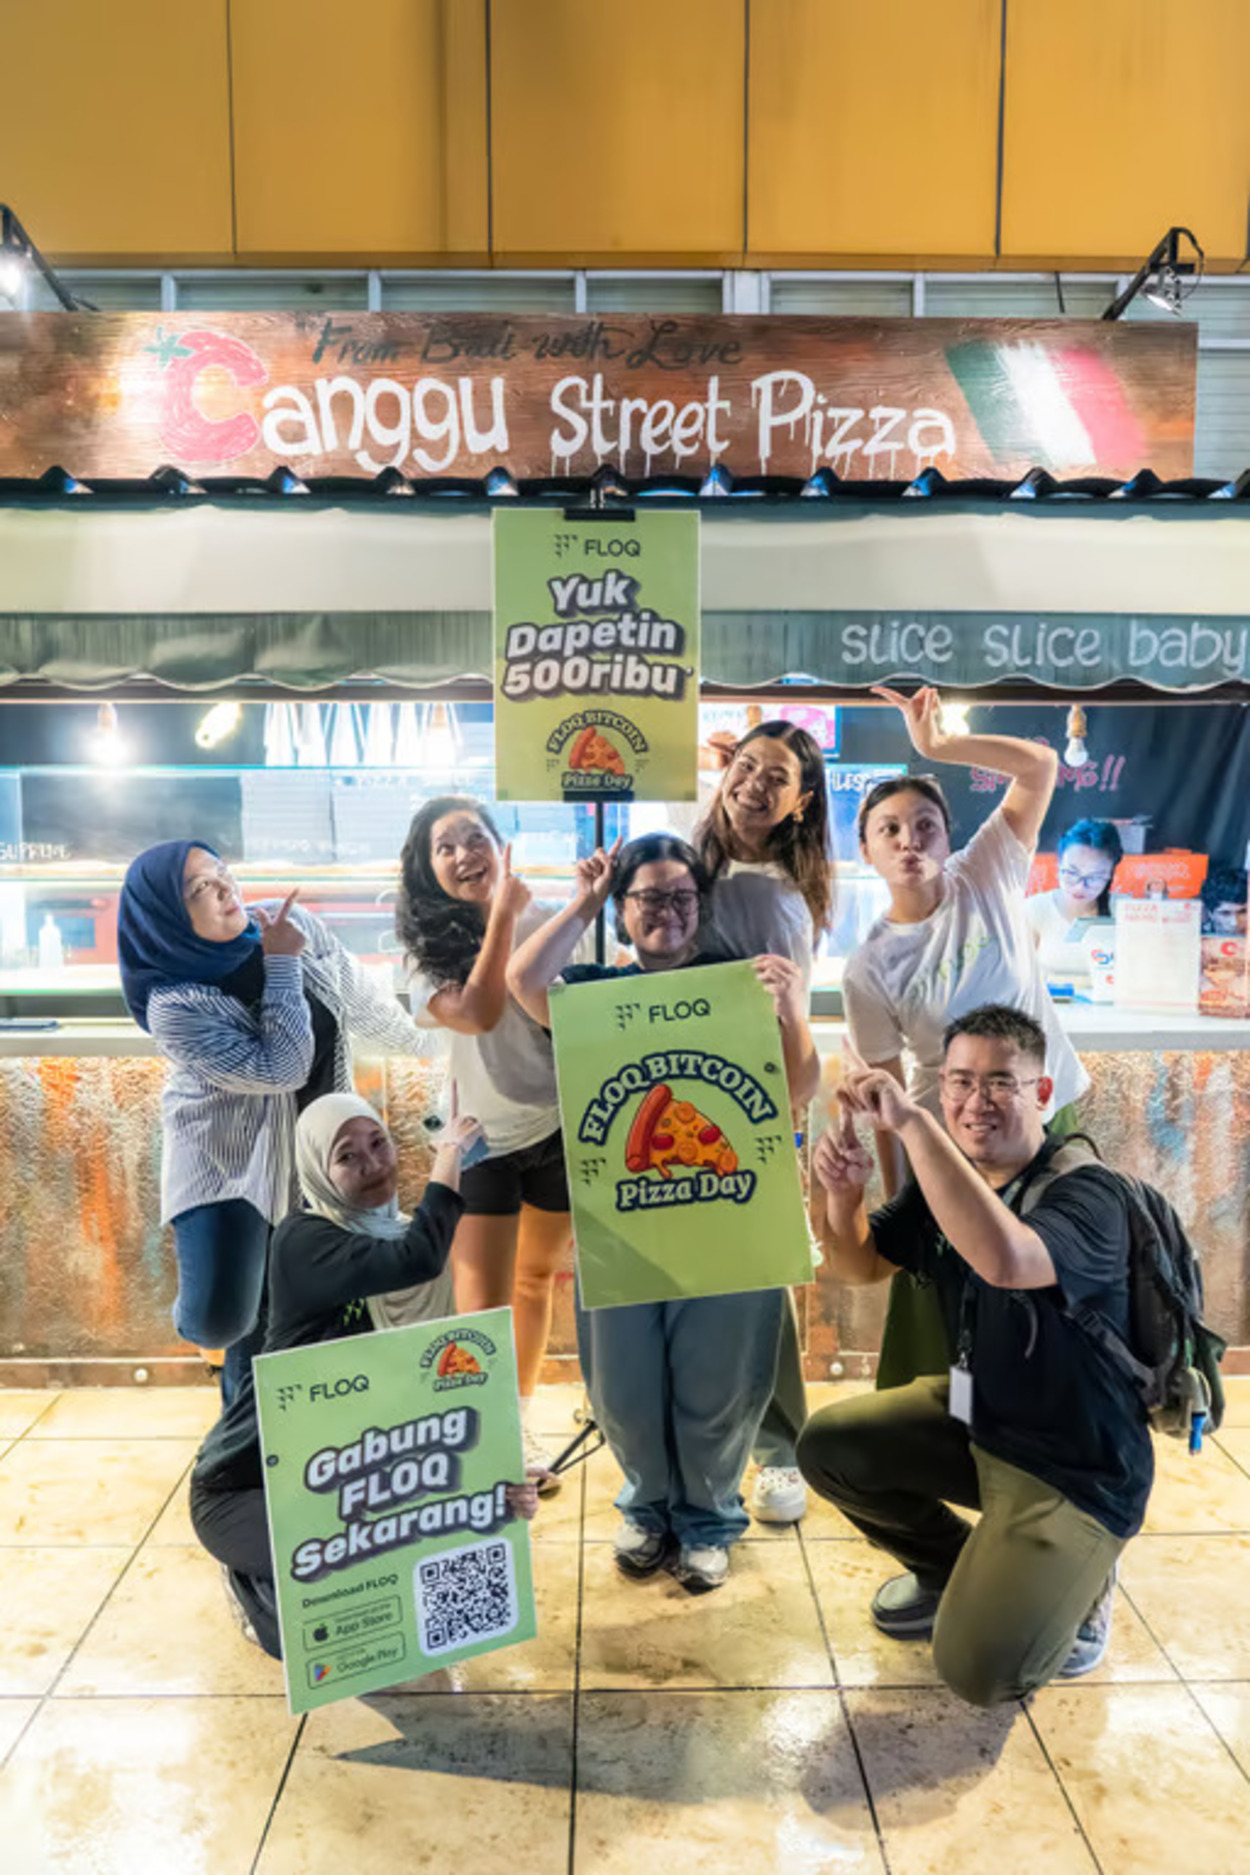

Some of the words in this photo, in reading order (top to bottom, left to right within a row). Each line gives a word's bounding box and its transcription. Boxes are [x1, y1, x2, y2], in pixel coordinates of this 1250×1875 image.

[312, 319, 401, 365] From
[531, 321, 625, 361] with
[626, 320, 742, 371] Love
[159, 330, 510, 474] Canggu
[550, 373, 732, 472] Street
[751, 370, 957, 473] Pizza
[584, 539, 642, 557] FLOQ
[548, 569, 638, 617] Yuk
[506, 609, 684, 660] Dapetin
[841, 621, 954, 665] slice
[983, 622, 1102, 667] slice
[1129, 619, 1249, 677] baby
[583, 710, 649, 754] BITCOIN
[649, 999, 711, 1023] FLOQ
[580, 1066, 648, 1144] FLOQ
[644, 1053, 776, 1121] BITCOIN
[618, 1178, 691, 1210] Pizza
[699, 1172, 754, 1203] Day
[309, 1374, 370, 1402] FLOQ
[304, 1408, 476, 1489] Gabung
[340, 1452, 459, 1521] FLOQ
[291, 1481, 509, 1582] Sekarang!
[364, 1573, 399, 1591] FLOQ
